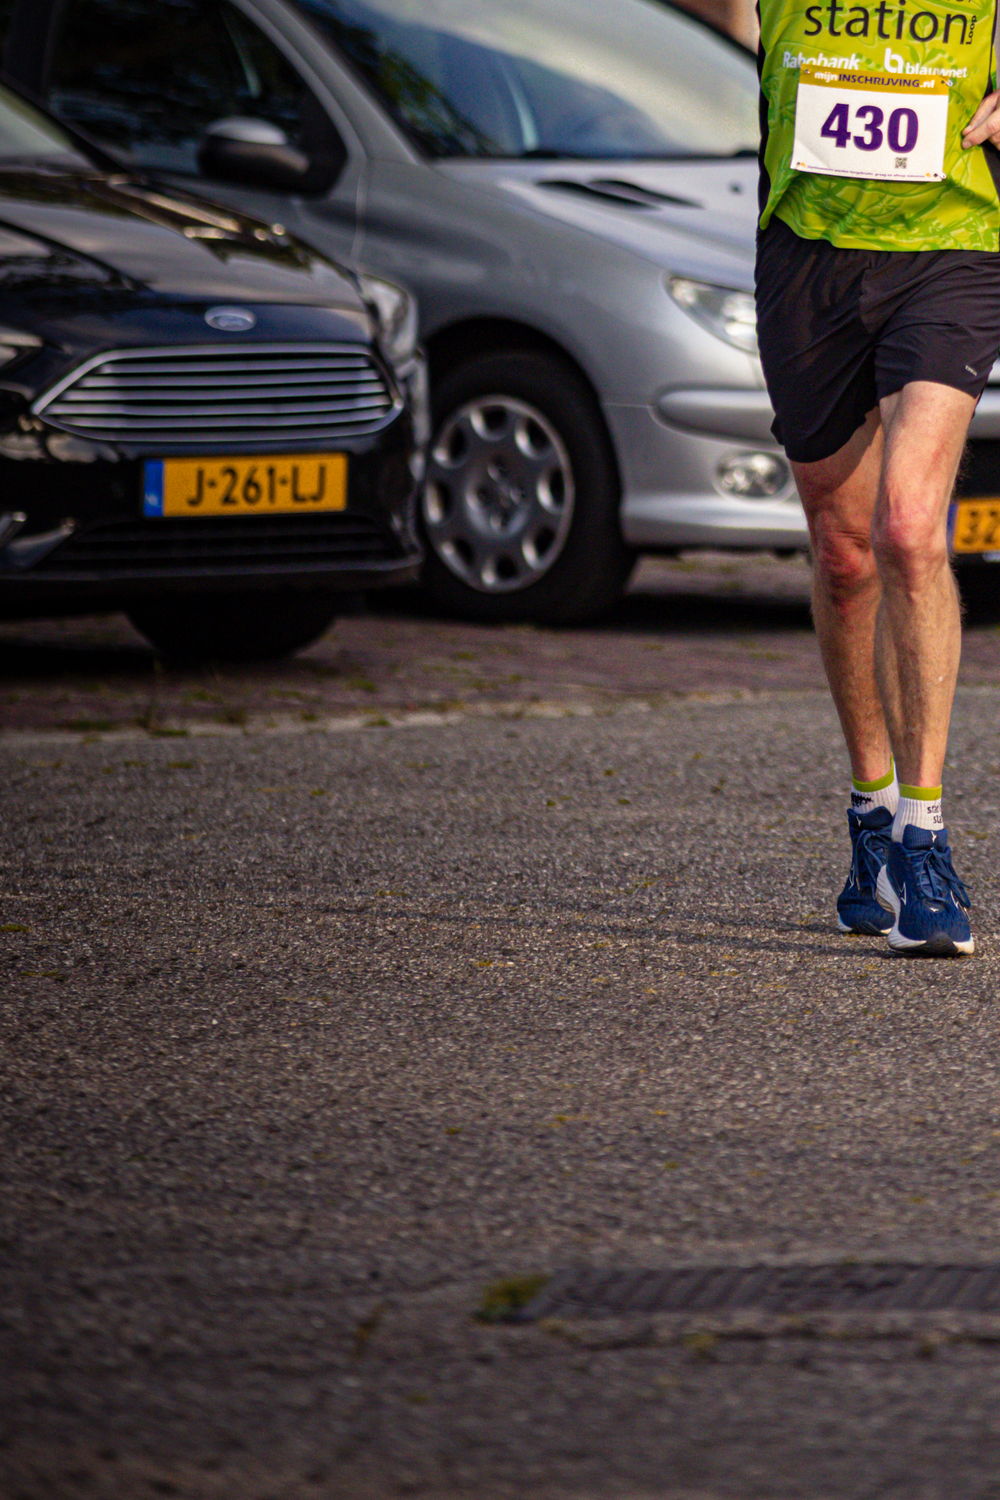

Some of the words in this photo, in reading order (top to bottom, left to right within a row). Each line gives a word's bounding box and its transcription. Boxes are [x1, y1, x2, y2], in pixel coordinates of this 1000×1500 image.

[782, 51, 861, 71] Rabobank
[905, 61, 968, 79] blauwnet
[814, 71, 935, 89] mijnINSCHRIJVING.nl
[820, 102, 919, 154] 430
[186, 465, 326, 508] J-261-LJ
